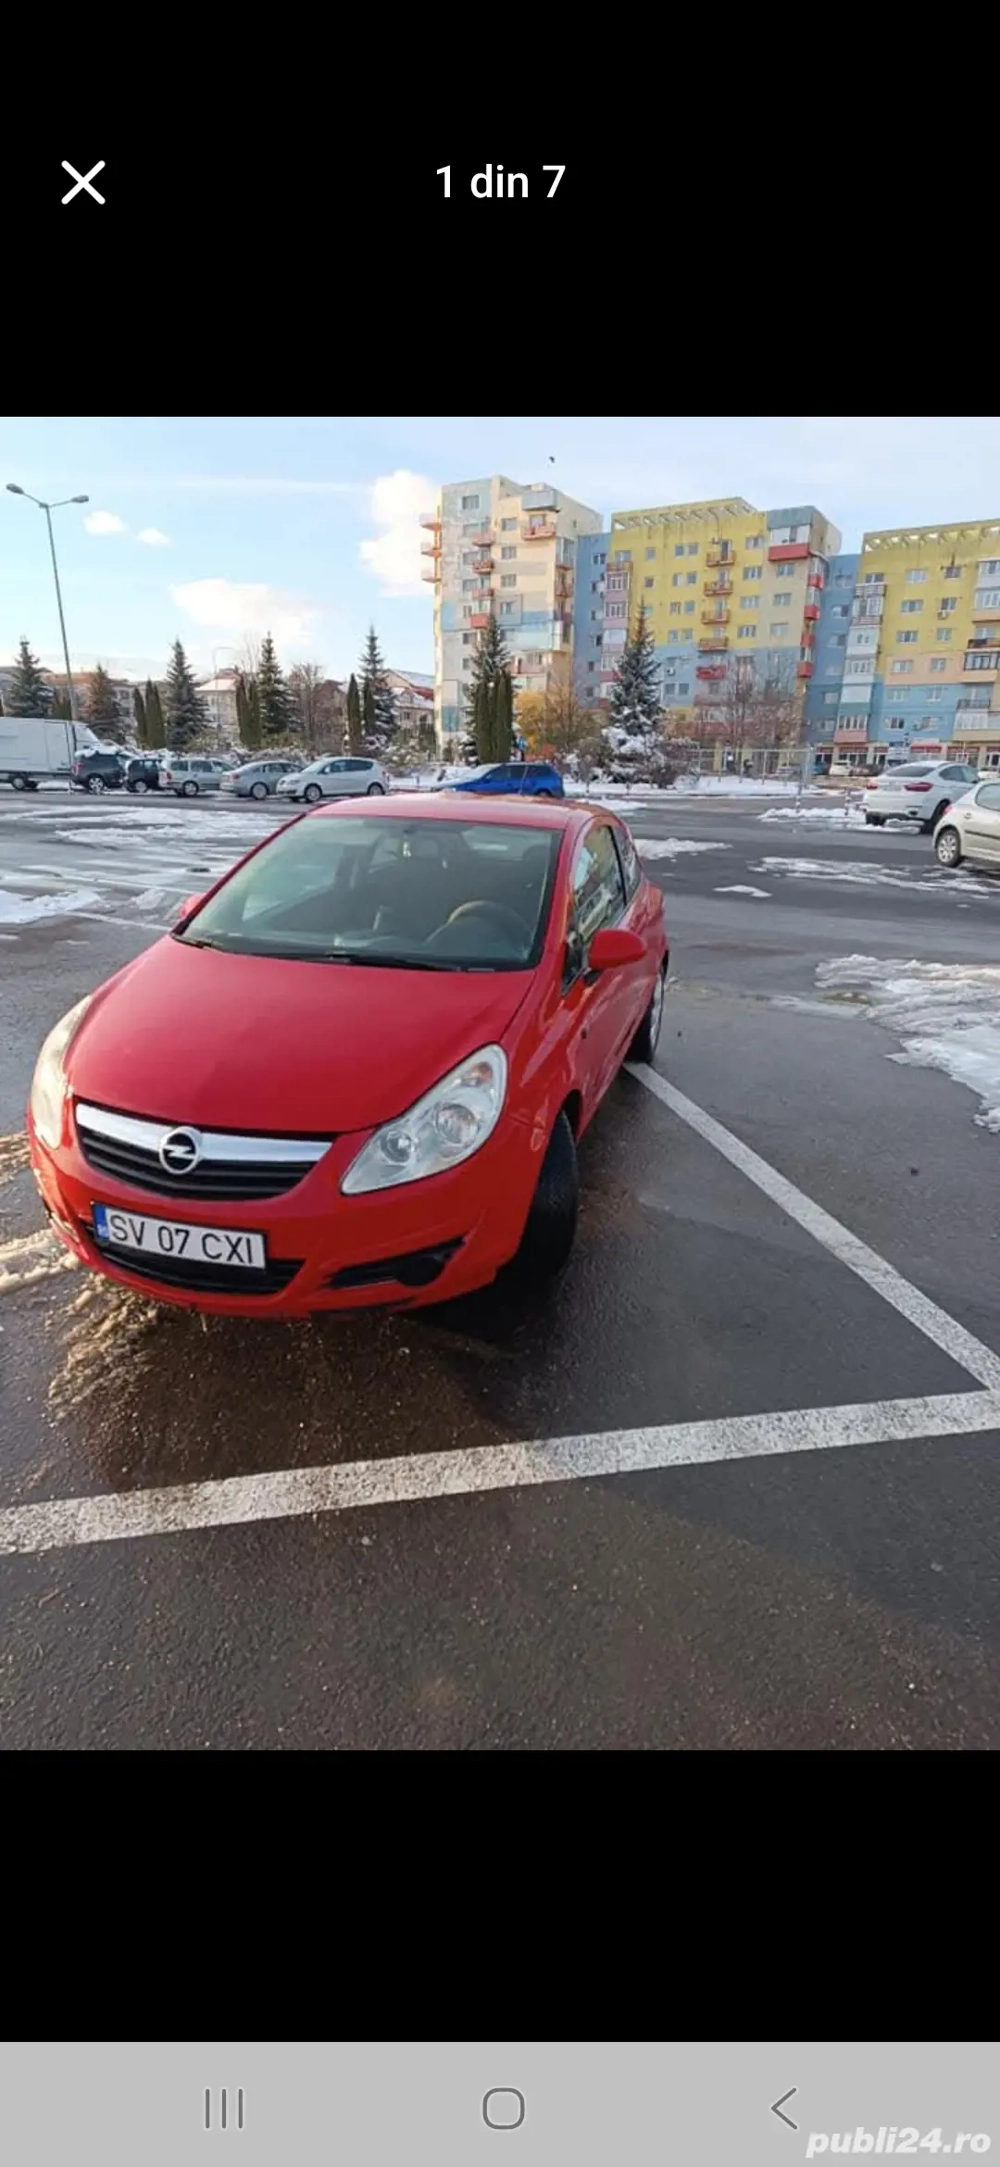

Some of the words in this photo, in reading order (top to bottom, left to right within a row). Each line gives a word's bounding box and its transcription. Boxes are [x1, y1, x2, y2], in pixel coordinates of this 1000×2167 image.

[109, 1214, 145, 1247] SV
[157, 1225, 190, 1255] 07
[201, 1232, 253, 1264] CXI
